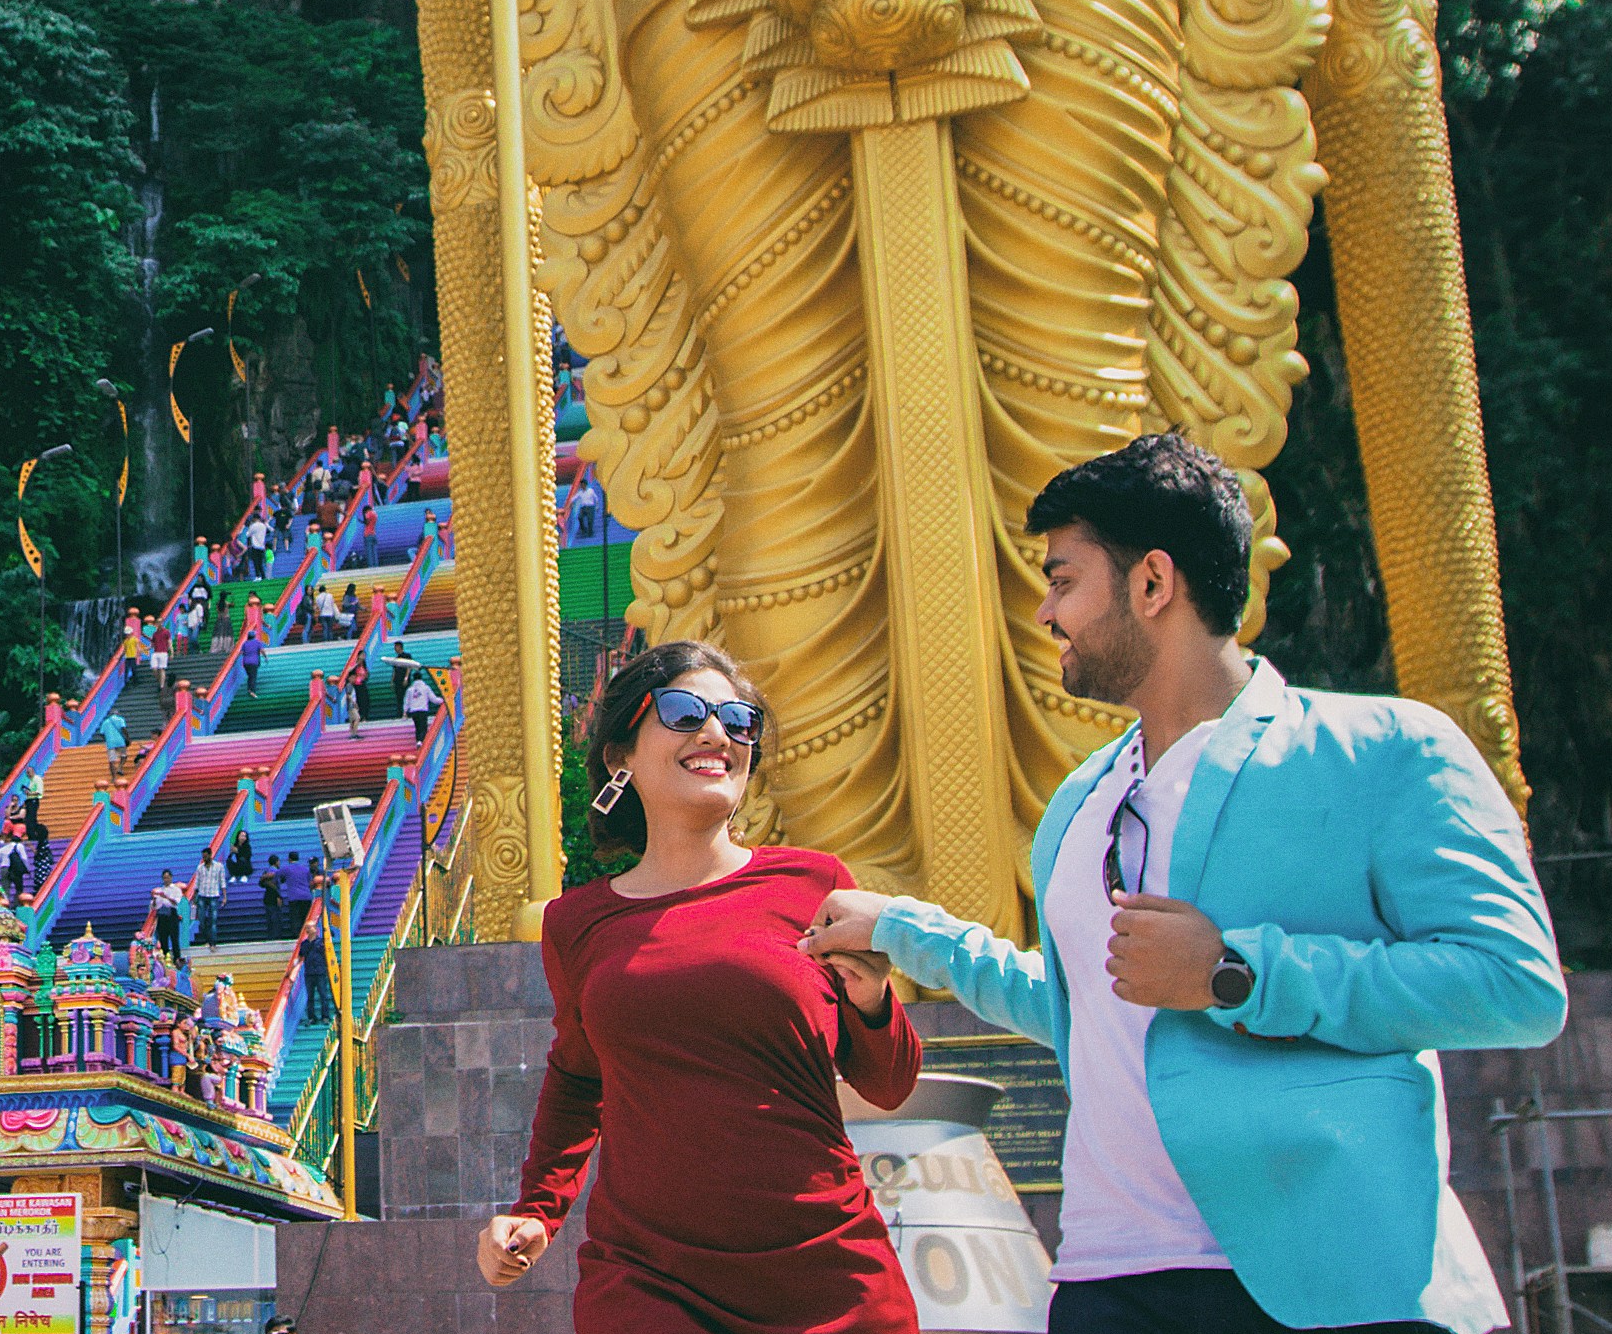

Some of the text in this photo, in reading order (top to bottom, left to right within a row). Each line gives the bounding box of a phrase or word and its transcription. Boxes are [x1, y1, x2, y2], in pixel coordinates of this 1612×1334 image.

[16, 1199, 27, 1208] KE
[29, 1198, 72, 1207] KAWASAN
[9, 1208, 52, 1217] MEROKOK
[25, 1247, 62, 1257] YOU ARE
[22, 1259, 65, 1268] ENTERING
